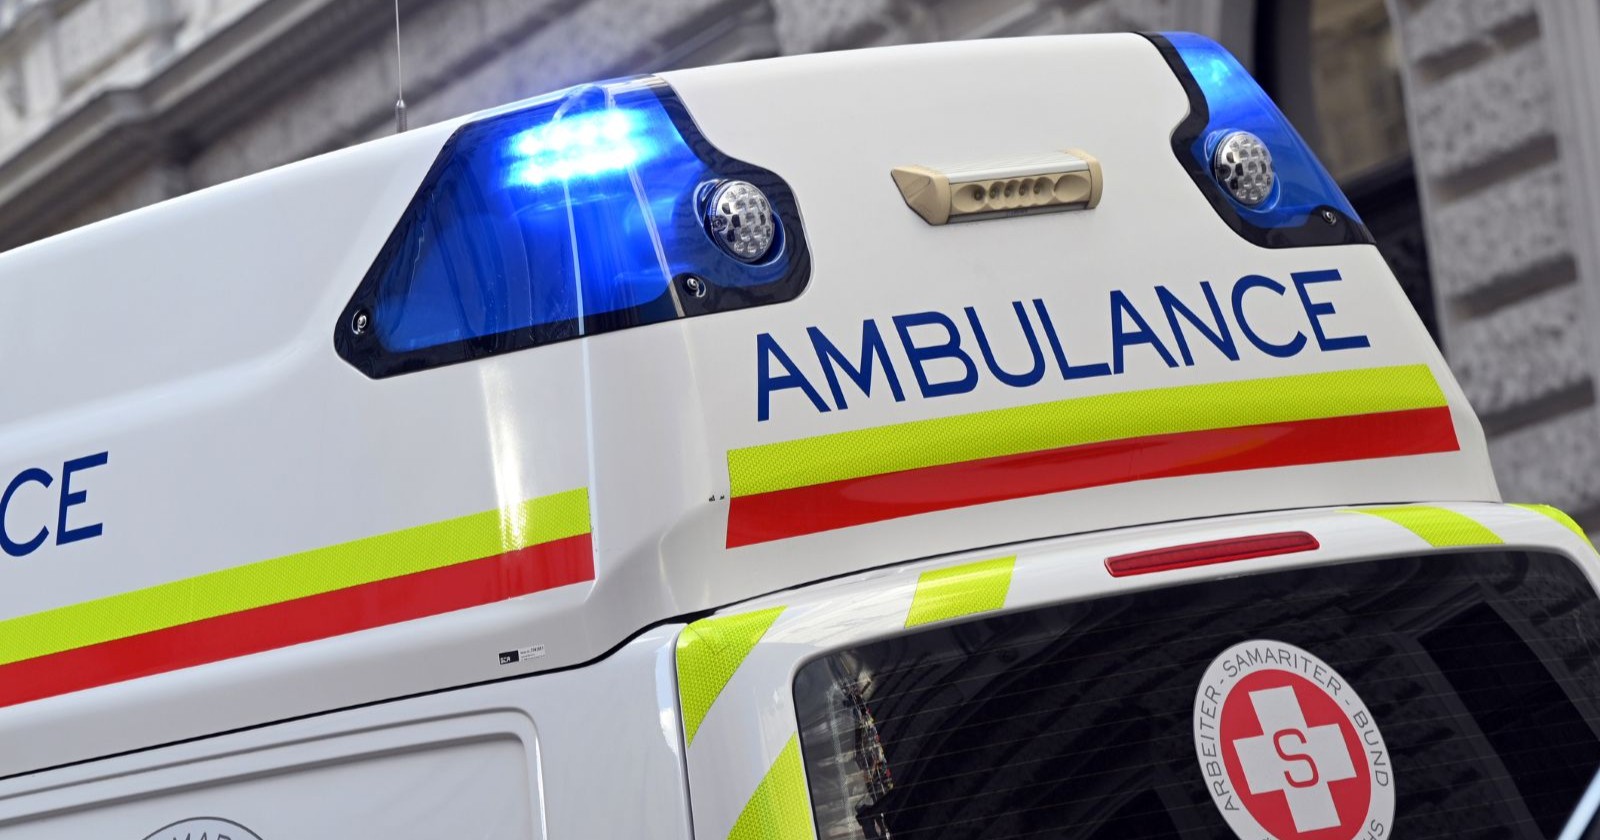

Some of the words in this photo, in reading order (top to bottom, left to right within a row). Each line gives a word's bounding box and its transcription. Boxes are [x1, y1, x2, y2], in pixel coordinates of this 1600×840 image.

[757, 269, 1370, 422] AMBULANCE
[1199, 685, 1240, 812] ARBEITER
[1222, 647, 1342, 695] SAMARITER
[1354, 711, 1389, 787] BUND
[1273, 728, 1319, 789] S
